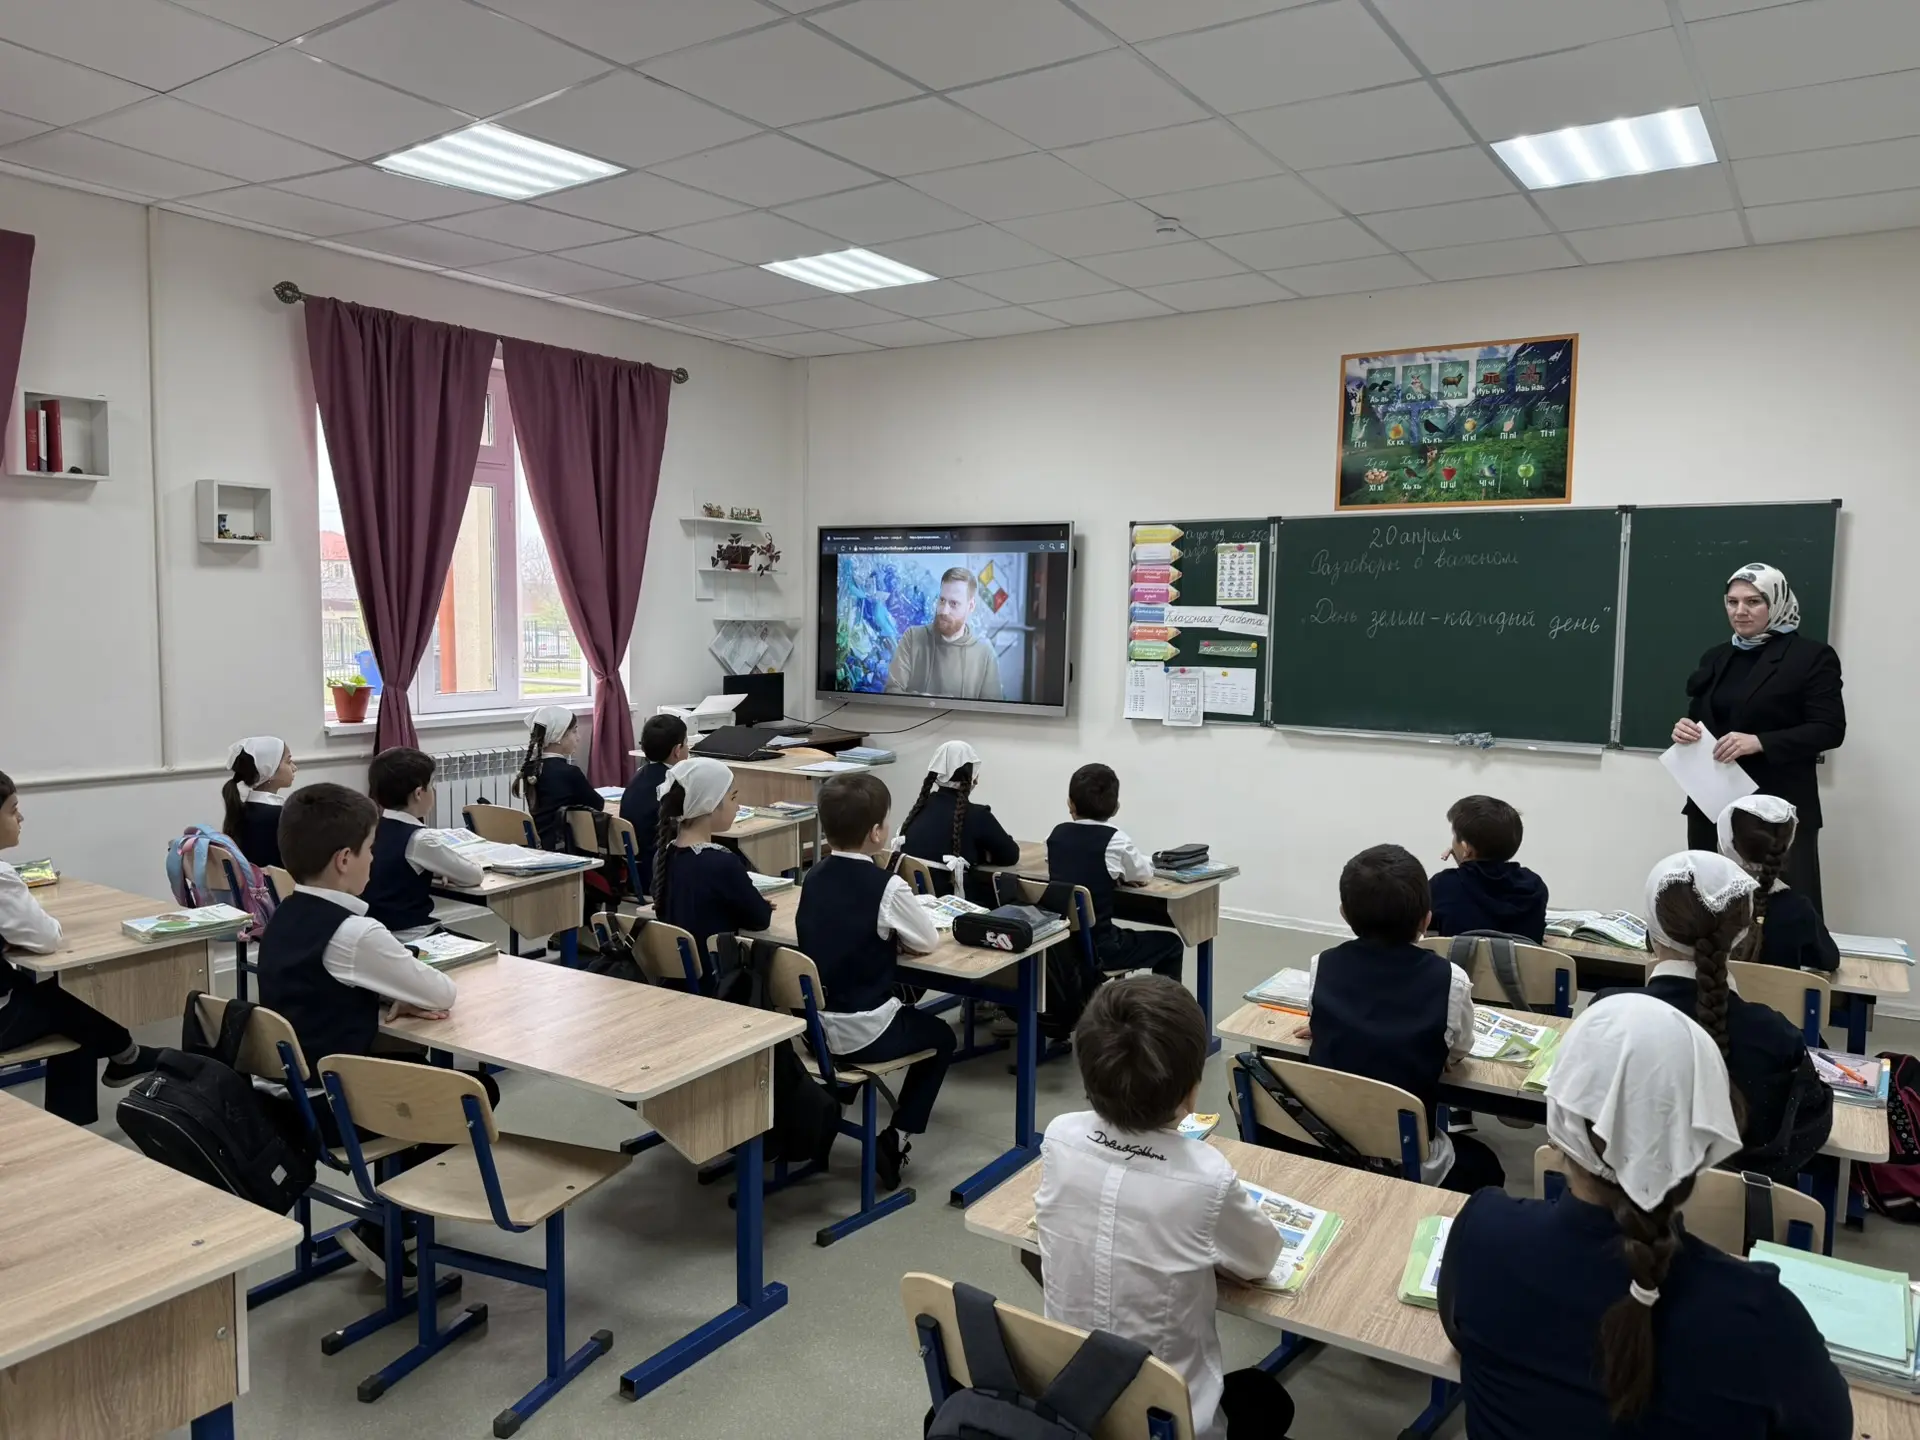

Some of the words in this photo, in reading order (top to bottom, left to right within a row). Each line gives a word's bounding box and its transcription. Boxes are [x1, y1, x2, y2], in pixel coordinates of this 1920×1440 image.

[1369, 526, 1399, 549] 20
[1400, 527, 1463, 555] апреля
[1308, 549, 1400, 586] Разговоры
[1414, 556, 1424, 570] о
[1434, 548, 1519, 568] важном
[1165, 610, 1214, 624] Классная
[1219, 611, 1265, 627] работа
[1443, 609, 1536, 635] каждый
